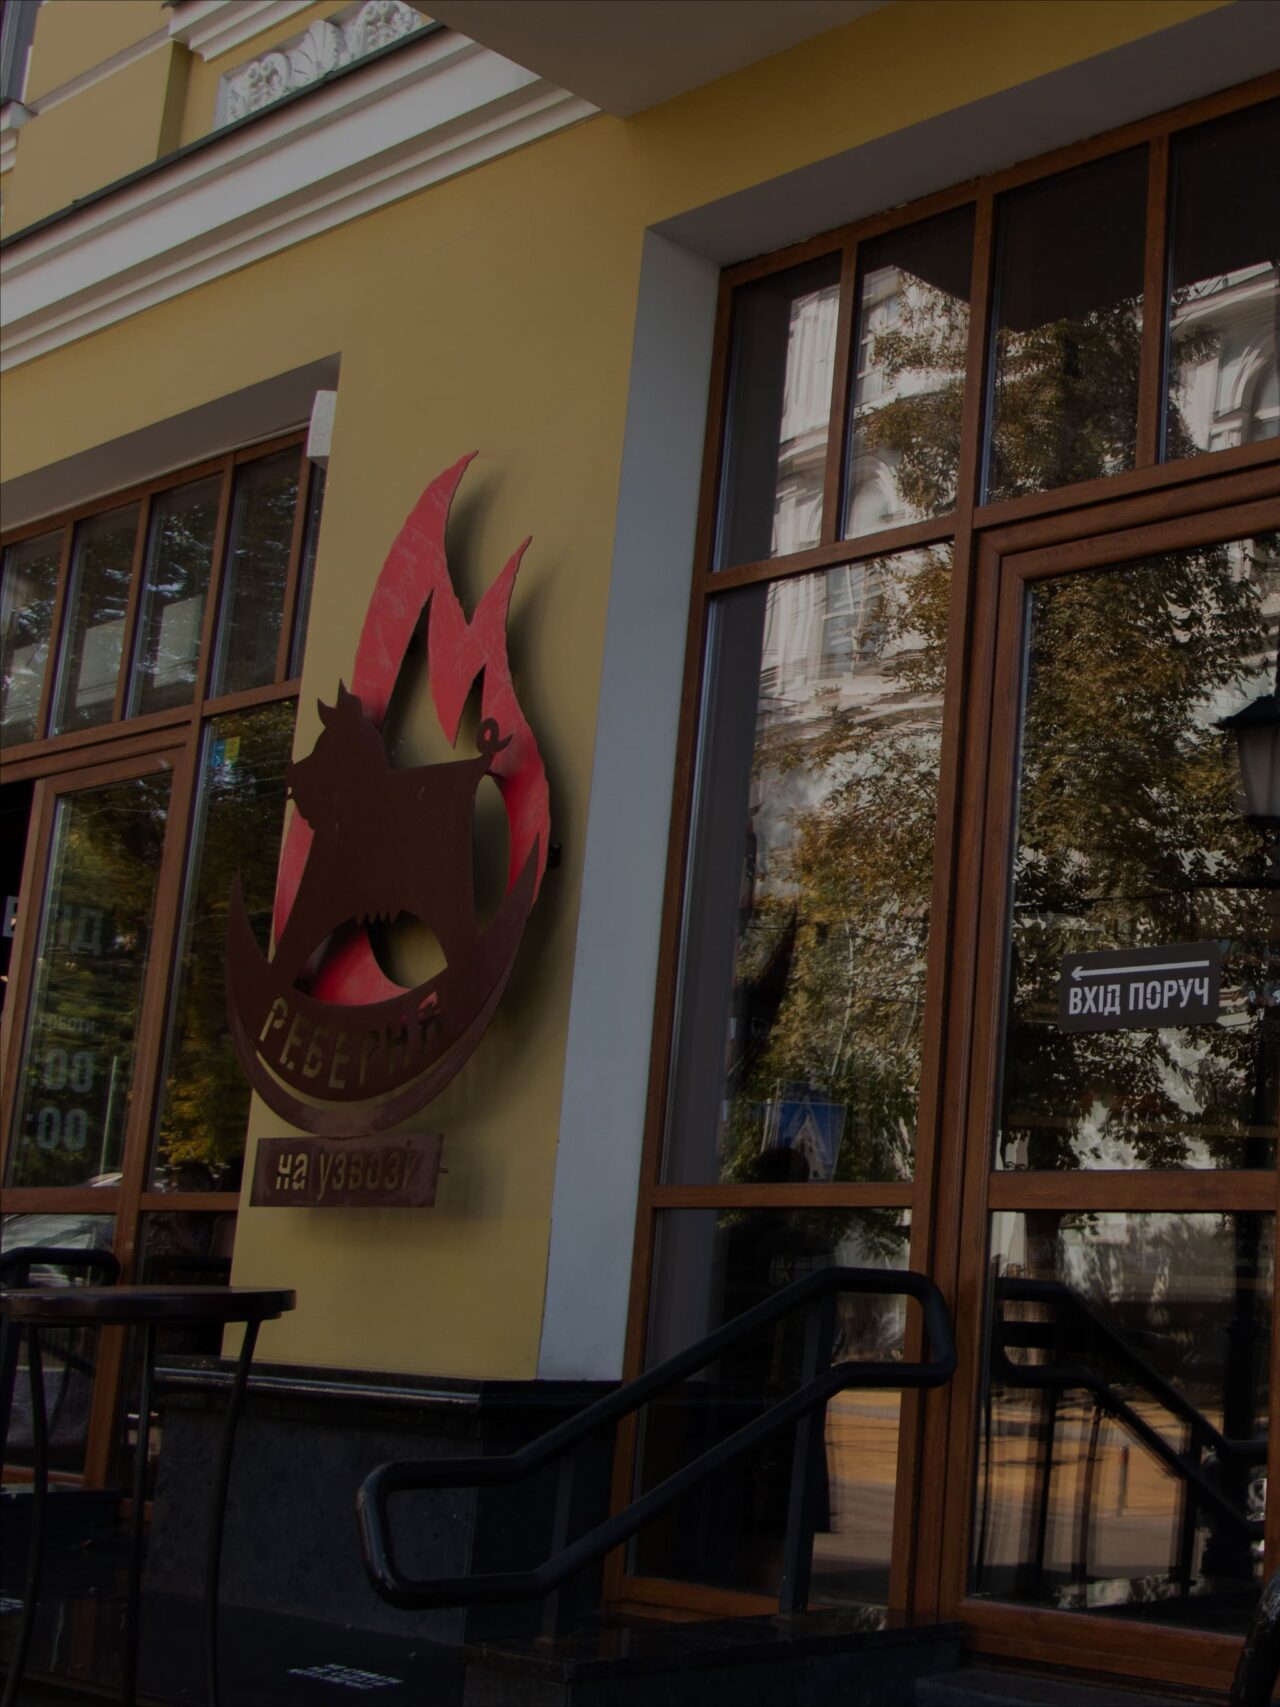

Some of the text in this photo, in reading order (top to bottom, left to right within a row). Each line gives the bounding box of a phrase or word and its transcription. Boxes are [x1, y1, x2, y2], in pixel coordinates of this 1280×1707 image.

[1068, 977, 1210, 1016] ВХІД ПОРУЧ
[258, 991, 443, 1091] РЕБЕРНЯ
